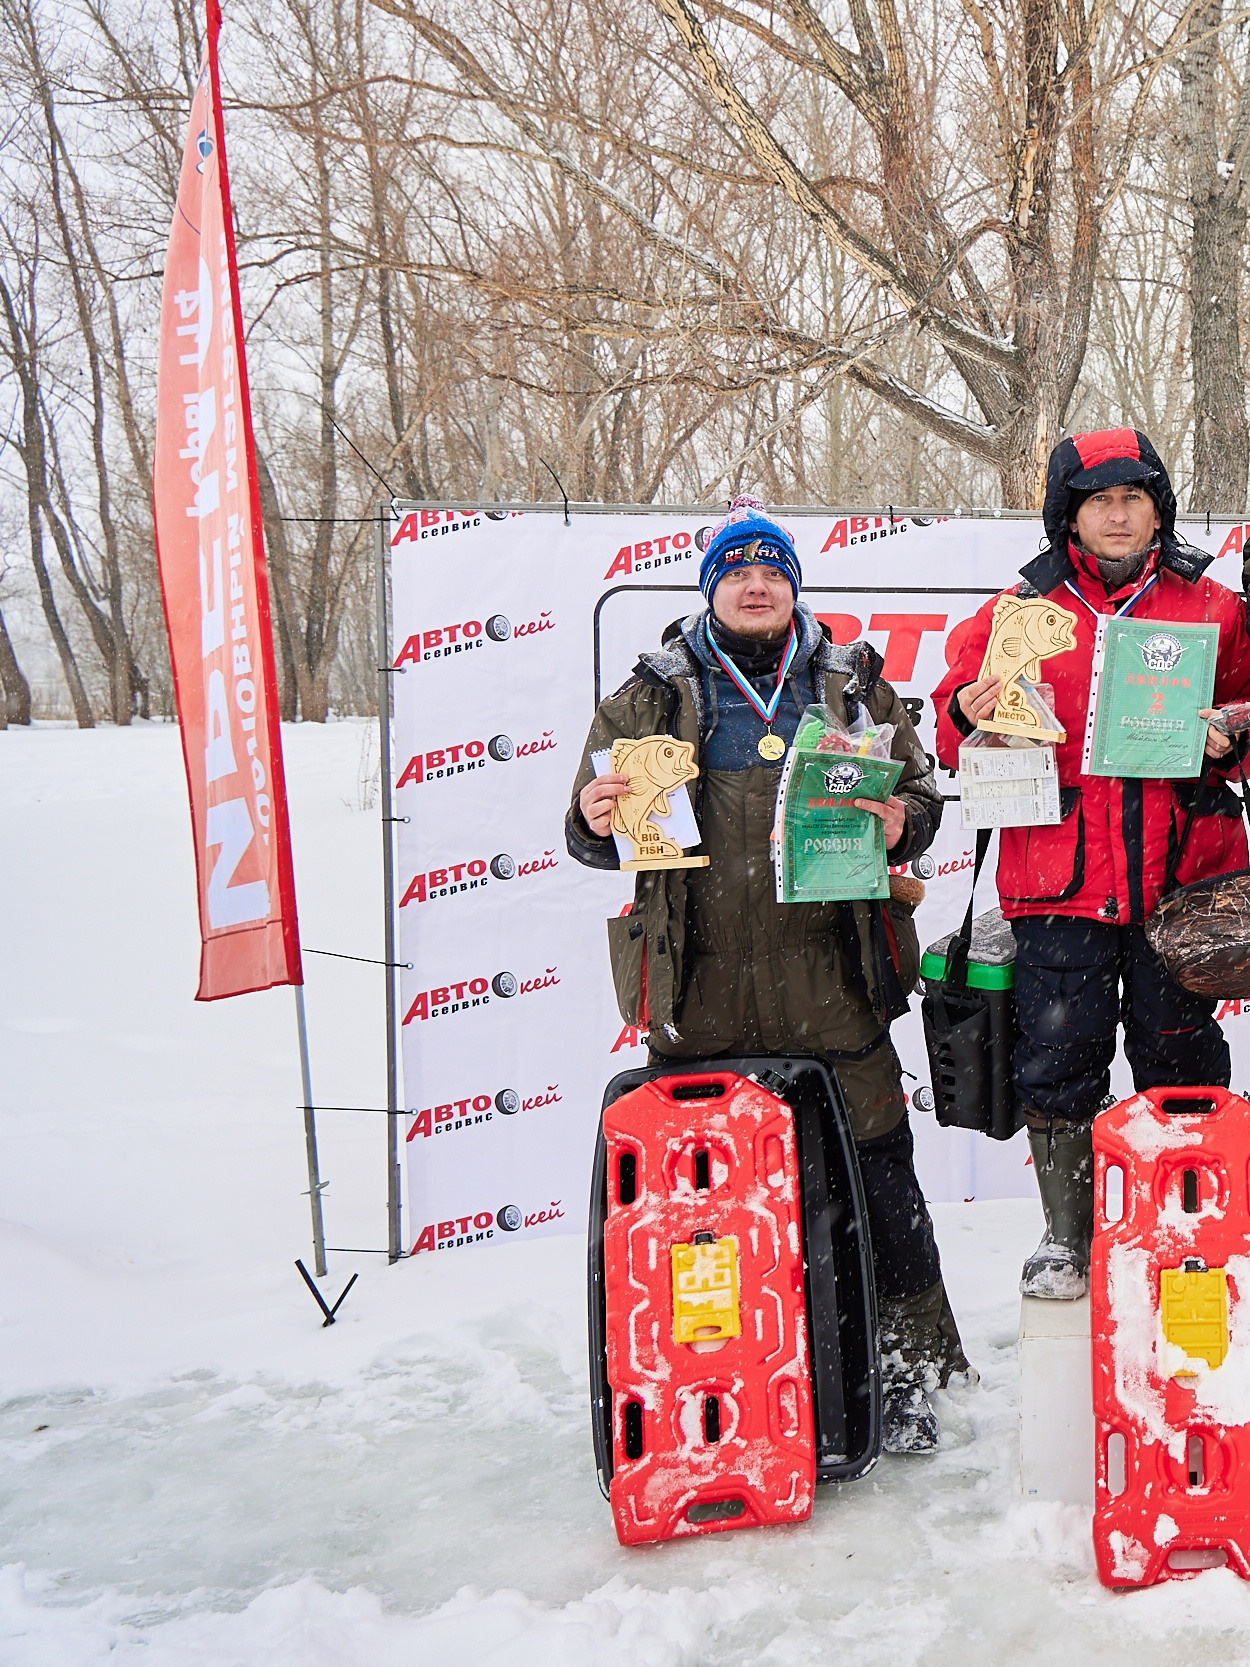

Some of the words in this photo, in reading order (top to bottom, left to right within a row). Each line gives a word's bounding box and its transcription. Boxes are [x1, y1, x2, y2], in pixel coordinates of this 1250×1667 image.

[421, 517, 481, 539] сервис
[850, 523, 907, 545] сервис
[604, 532, 692, 580] АВТО
[634, 549, 692, 572] сервис
[393, 621, 483, 668] АВТО
[423, 638, 483, 661] сервис
[1124, 673, 1192, 689] ДИПЛОМ
[1007, 690, 1021, 707] 2
[1151, 691, 1165, 710] 2
[997, 710, 1026, 722] МЕСТО
[396, 741, 485, 789] АВТО
[426, 759, 486, 781] сервис
[806, 797, 855, 809] ДИПЛО
[641, 833, 660, 842] BIG
[803, 838, 863, 853] РОССИЯ
[639, 845, 664, 855] FISH
[399, 860, 488, 908] АВТО
[429, 878, 488, 900] сервис
[401, 977, 489, 1026] АВТО
[431, 995, 489, 1018] сервис
[406, 1094, 492, 1142] АВТО
[435, 1112, 493, 1135] сервис
[410, 1211, 494, 1256] АВТО
[437, 1229, 494, 1250] сервис
